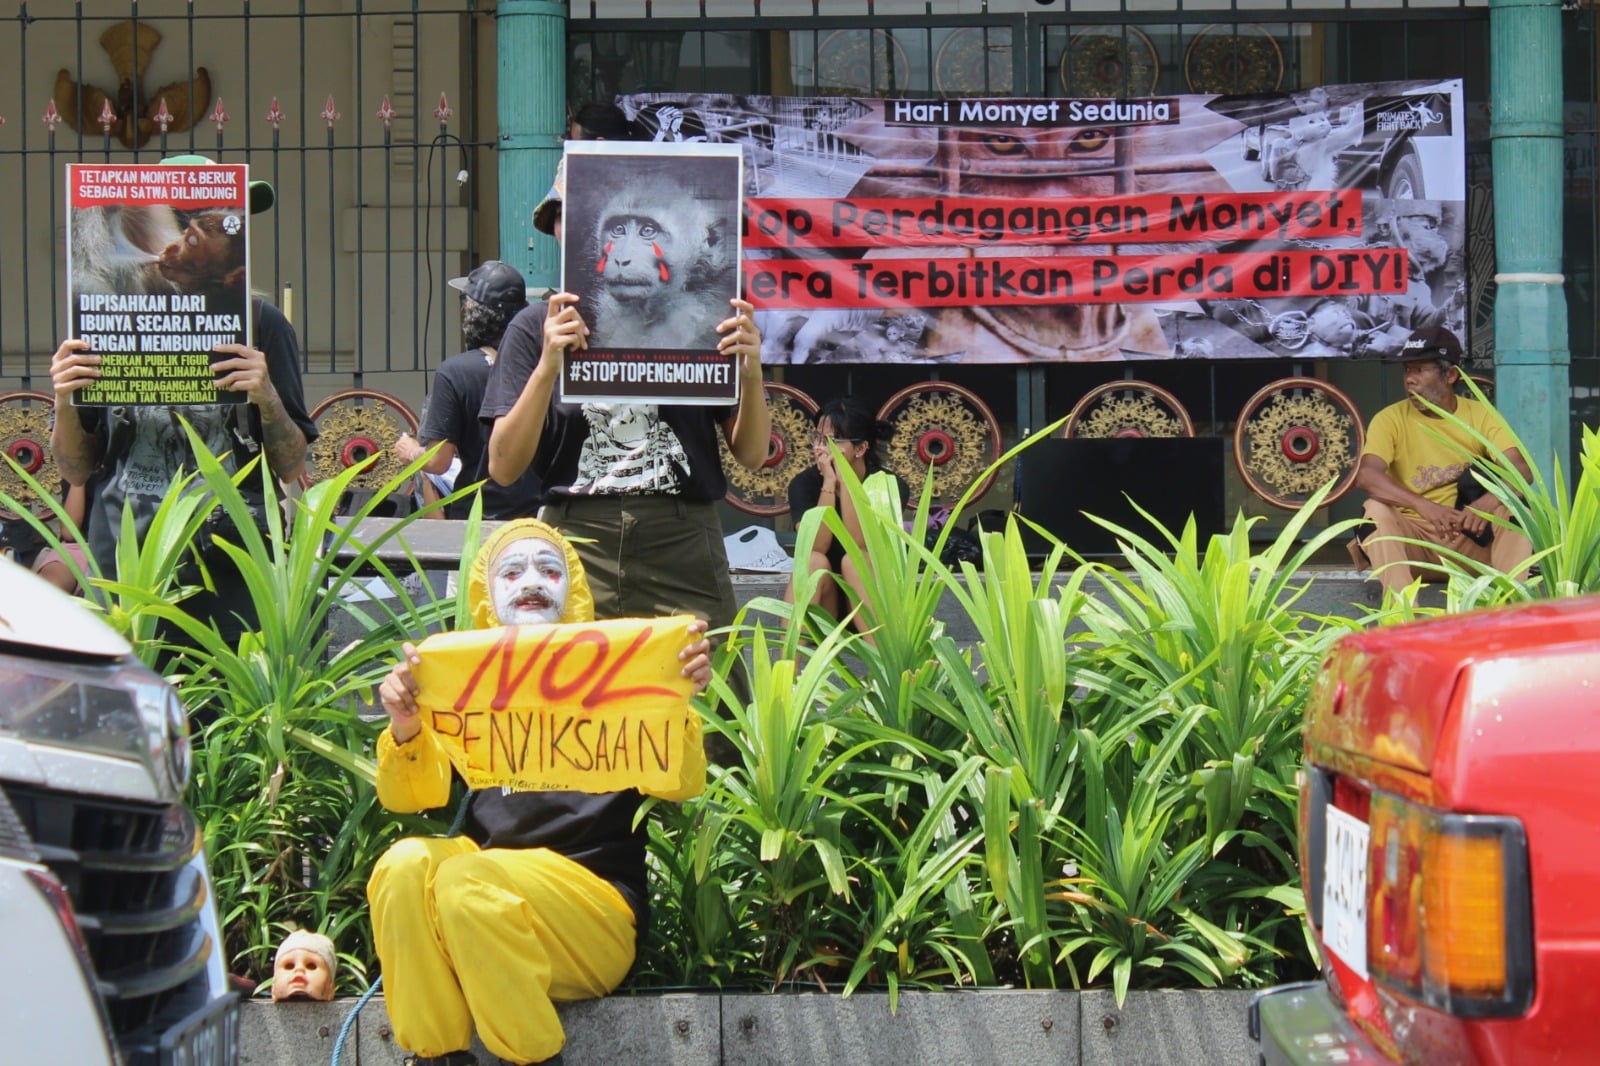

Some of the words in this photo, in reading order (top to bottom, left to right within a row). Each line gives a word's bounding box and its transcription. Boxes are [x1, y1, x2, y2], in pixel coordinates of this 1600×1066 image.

[894, 101, 949, 122] Hari
[959, 101, 1060, 126] Monyet
[1069, 101, 1170, 122] Sedunia
[1376, 111, 1415, 121] PRIMATES
[1376, 122, 1398, 132] FIGHT
[79, 170, 138, 184] TETAPKAN
[140, 171, 186, 184] MONYET
[188, 172, 197, 185] &
[198, 171, 236, 185] BERUK
[79, 185, 127, 199] SEBAGAI
[130, 186, 168, 199] SATWA
[171, 186, 237, 200] DILINDUNGI
[742, 200, 813, 245] top
[832, 198, 1148, 242] Perdagangan
[1167, 191, 1357, 238] Monyet,
[742, 267, 833, 300] era
[852, 261, 1073, 299] Terbitkan
[1092, 258, 1233, 297] Perda
[1253, 254, 1291, 292] di
[1310, 252, 1404, 291] DIY!
[80, 294, 167, 313] DIPISAHKAN
[171, 295, 206, 312] DARI
[80, 314, 132, 331] IBUNYA
[136, 314, 190, 332] SECARA
[195, 315, 241, 331] PAKSA
[99, 355, 141, 366] MERKAN
[144, 355, 178, 366] PUBLIK
[181, 355, 209, 366] FIGUR
[124, 366, 154, 377] SATWA
[569, 361, 730, 384] #STOPTOPENGMONYET
[130, 381, 198, 392] PERDAGANGAN
[82, 391, 103, 402] LIAR
[106, 392, 136, 402] MAKIN
[140, 392, 157, 402] TAK
[159, 392, 217, 402] TERKENDALI
[453, 624, 683, 712] NOL
[432, 711, 670, 774] PENYIKSAAN
